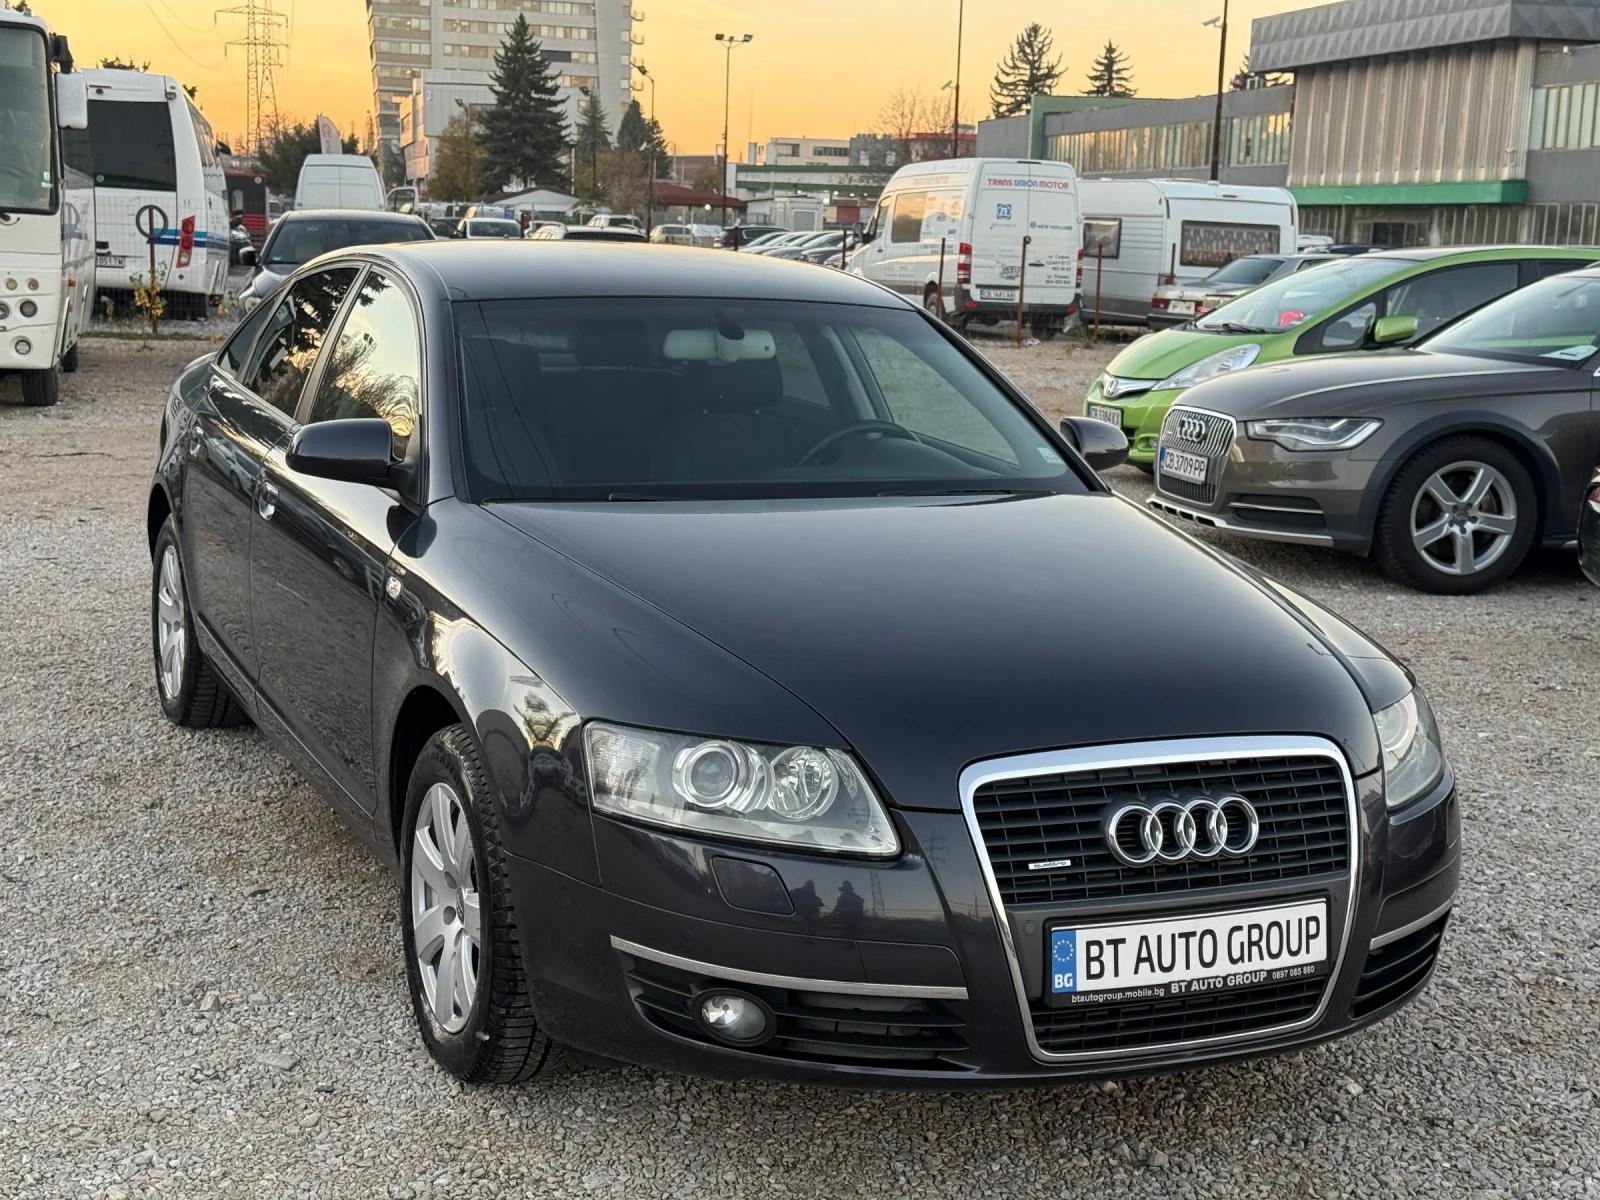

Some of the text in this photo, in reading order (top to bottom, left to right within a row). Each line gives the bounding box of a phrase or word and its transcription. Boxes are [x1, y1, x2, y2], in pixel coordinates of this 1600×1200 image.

[987, 178, 1069, 190] TRANS UNION MOTOR
[1165, 452, 1206, 478] CB 3709 PP
[1085, 915, 1321, 981] BT AUTO GROUP
[1054, 973, 1073, 988] BG
[1071, 965, 1315, 1004] btautogroup.mobile.bg BT AUTO GROUP 0897 085 880
